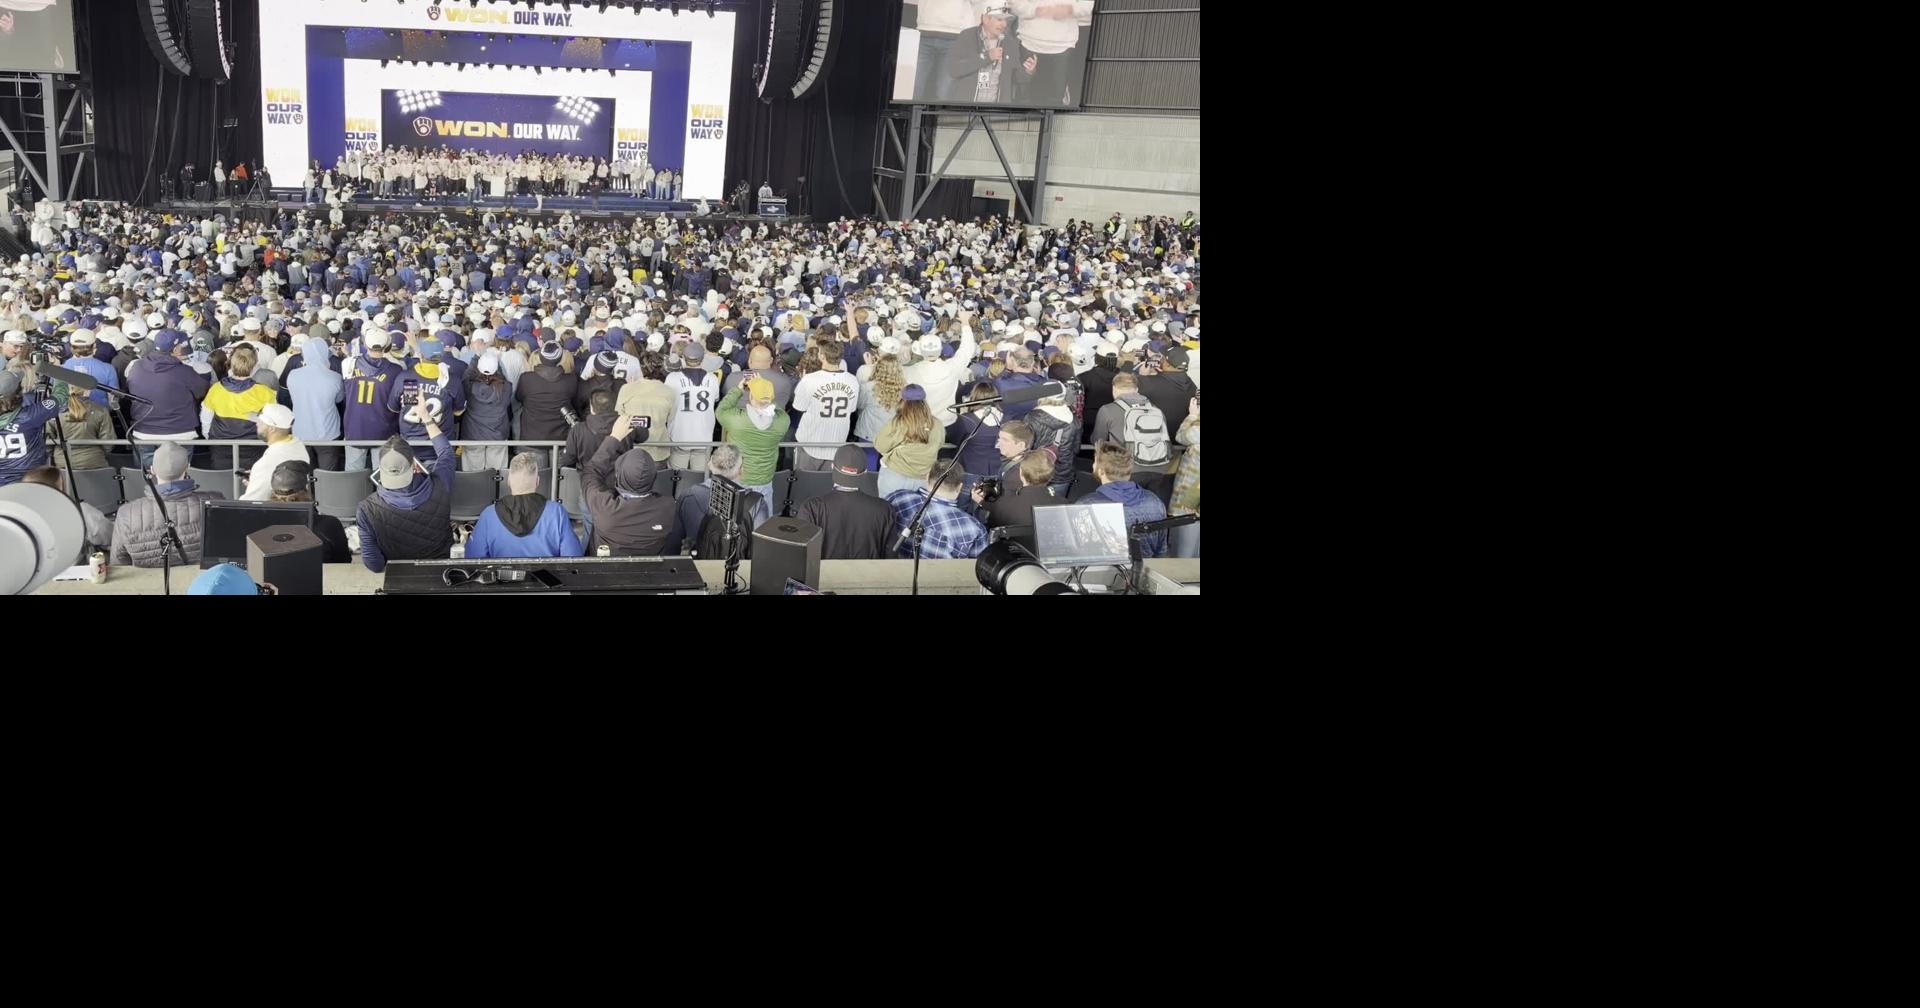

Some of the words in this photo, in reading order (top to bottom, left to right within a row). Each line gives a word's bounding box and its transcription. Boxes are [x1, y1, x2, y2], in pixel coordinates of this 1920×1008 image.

[513, 11, 540, 26] OUR
[266, 103, 302, 113] OUR
[267, 113, 292, 124] WAY
[690, 119, 723, 128] OUR
[435, 120, 511, 138] WON.
[513, 123, 543, 139] OUR
[546, 124, 580, 141] WAY.
[690, 128, 712, 139] WAY
[345, 132, 377, 141] OUR
[345, 141, 368, 151] WAY
[617, 142, 648, 150] OUR
[617, 150, 638, 160] WAY
[357, 380, 376, 404] 11
[680, 390, 710, 413] 18
[820, 397, 848, 418] 32
